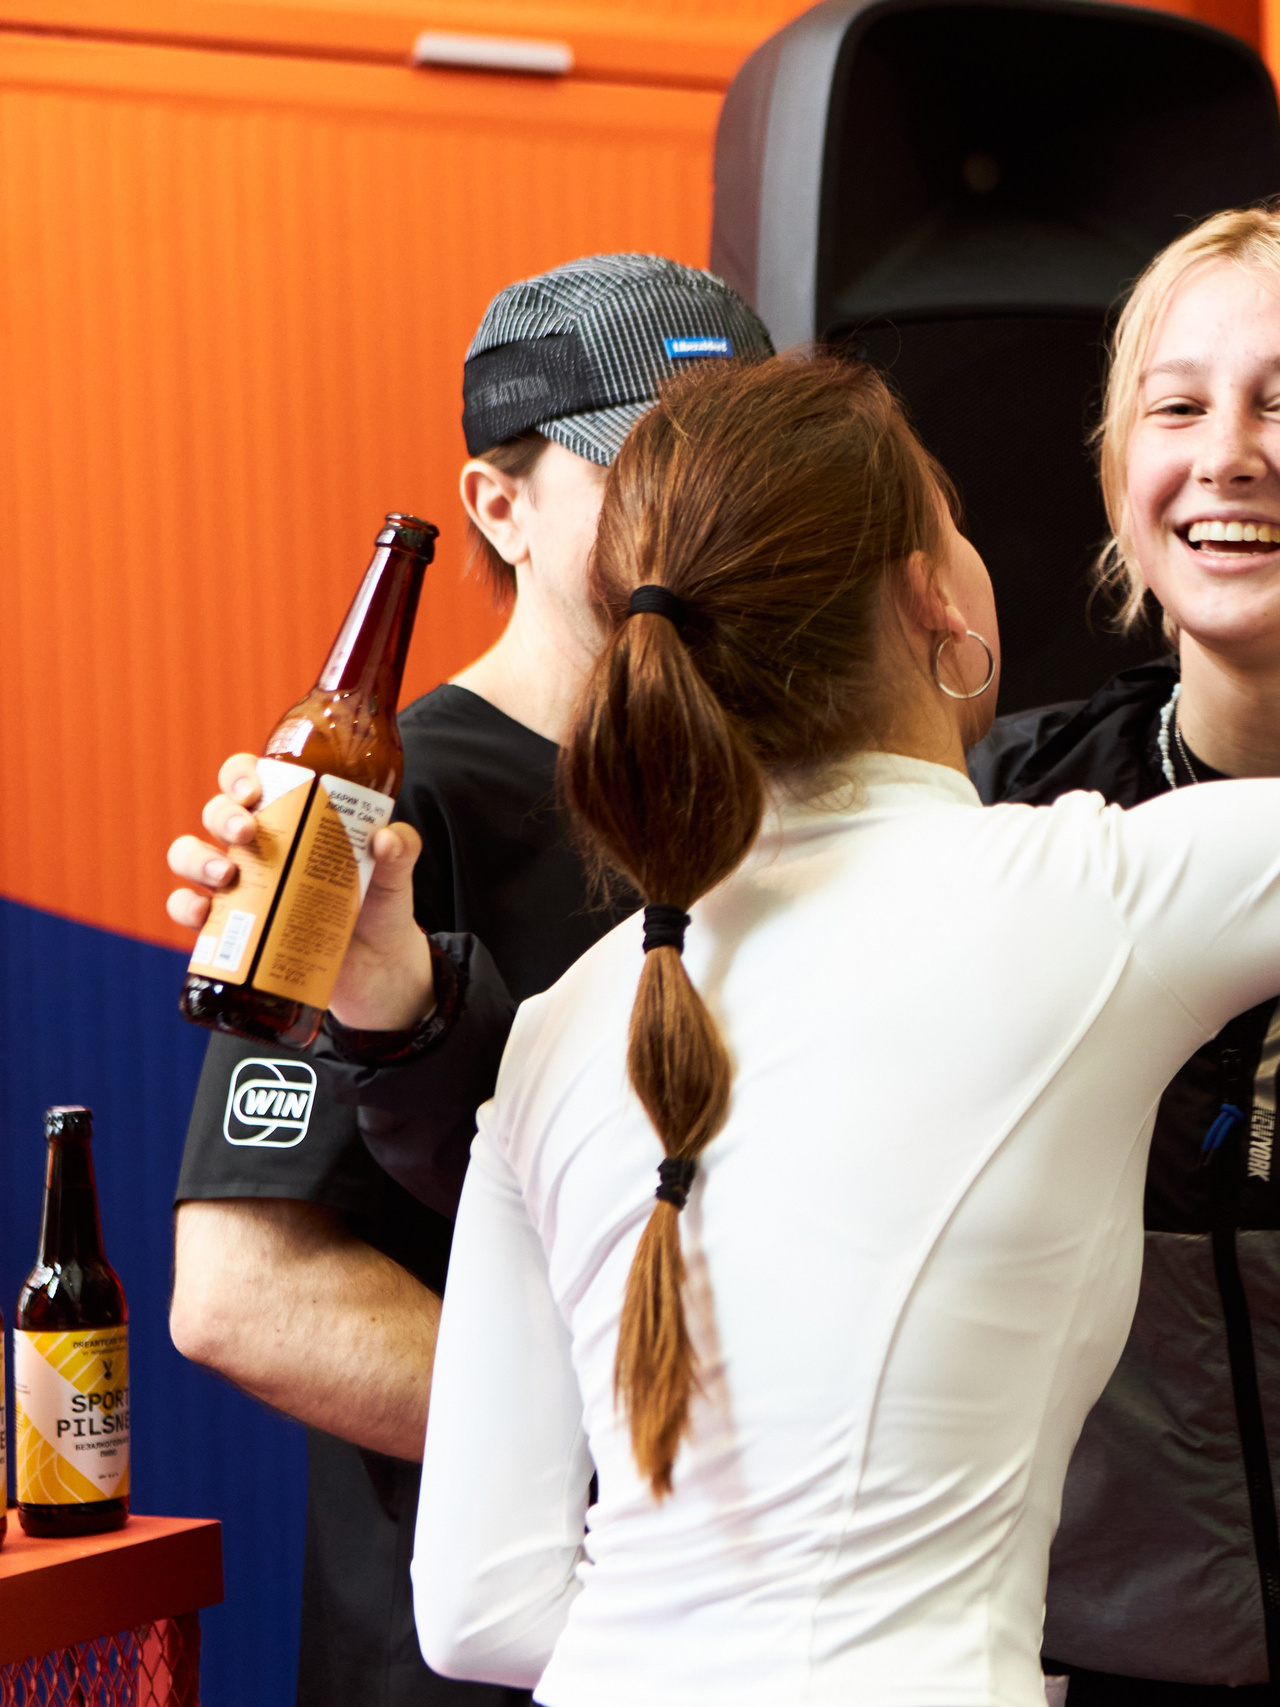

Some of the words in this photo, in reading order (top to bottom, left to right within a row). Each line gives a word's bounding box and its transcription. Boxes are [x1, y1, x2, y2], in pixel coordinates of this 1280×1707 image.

[245, 1089, 308, 1119] WIN
[72, 1388, 128, 1413] SPORT
[57, 1410, 130, 1438] PILSNE
